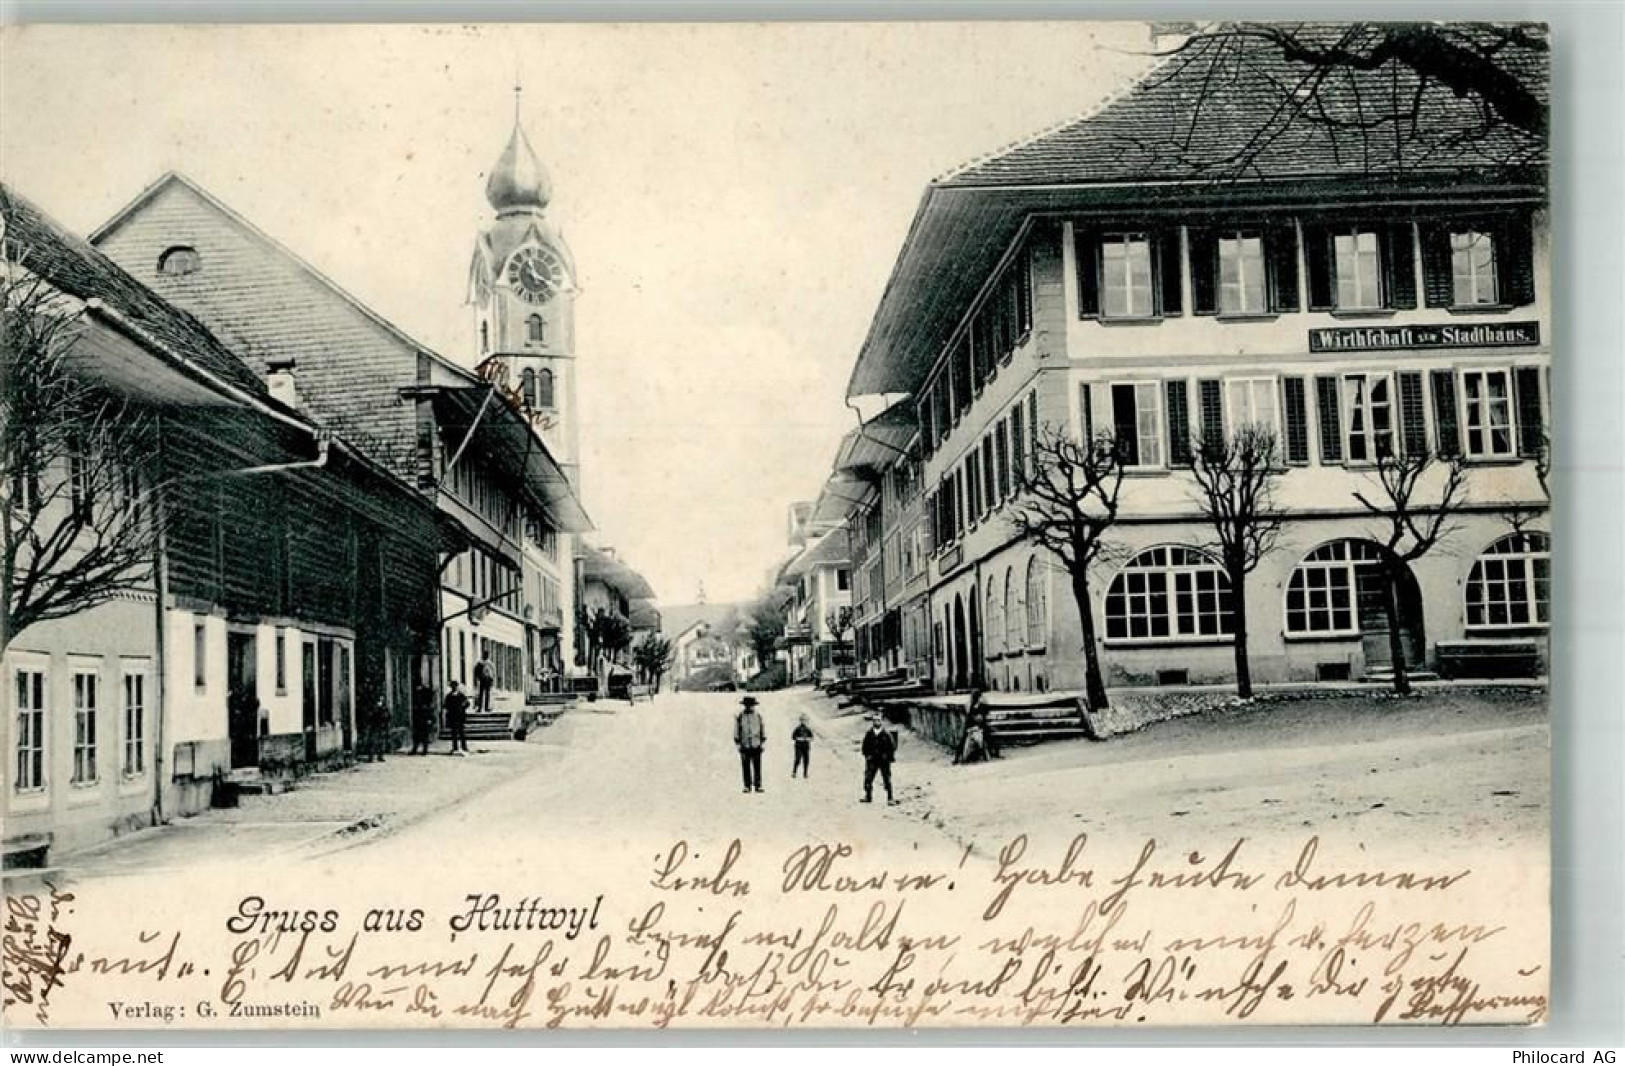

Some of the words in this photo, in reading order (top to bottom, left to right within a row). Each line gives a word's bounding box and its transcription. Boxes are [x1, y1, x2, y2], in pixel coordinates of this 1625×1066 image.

[1442, 325, 1531, 345] Stadthaus.
[650, 839, 750, 896] Liebe
[982, 834, 1094, 921] Habe
[1099, 838, 1265, 915] heute
[227, 897, 338, 933] Gruss
[363, 905, 424, 932] aus
[450, 894, 603, 940] Huttwyl
[108, 1001, 185, 1020] Verlag:
[196, 1001, 218, 1018] G.
[229, 1001, 321, 1018] Zumstein
